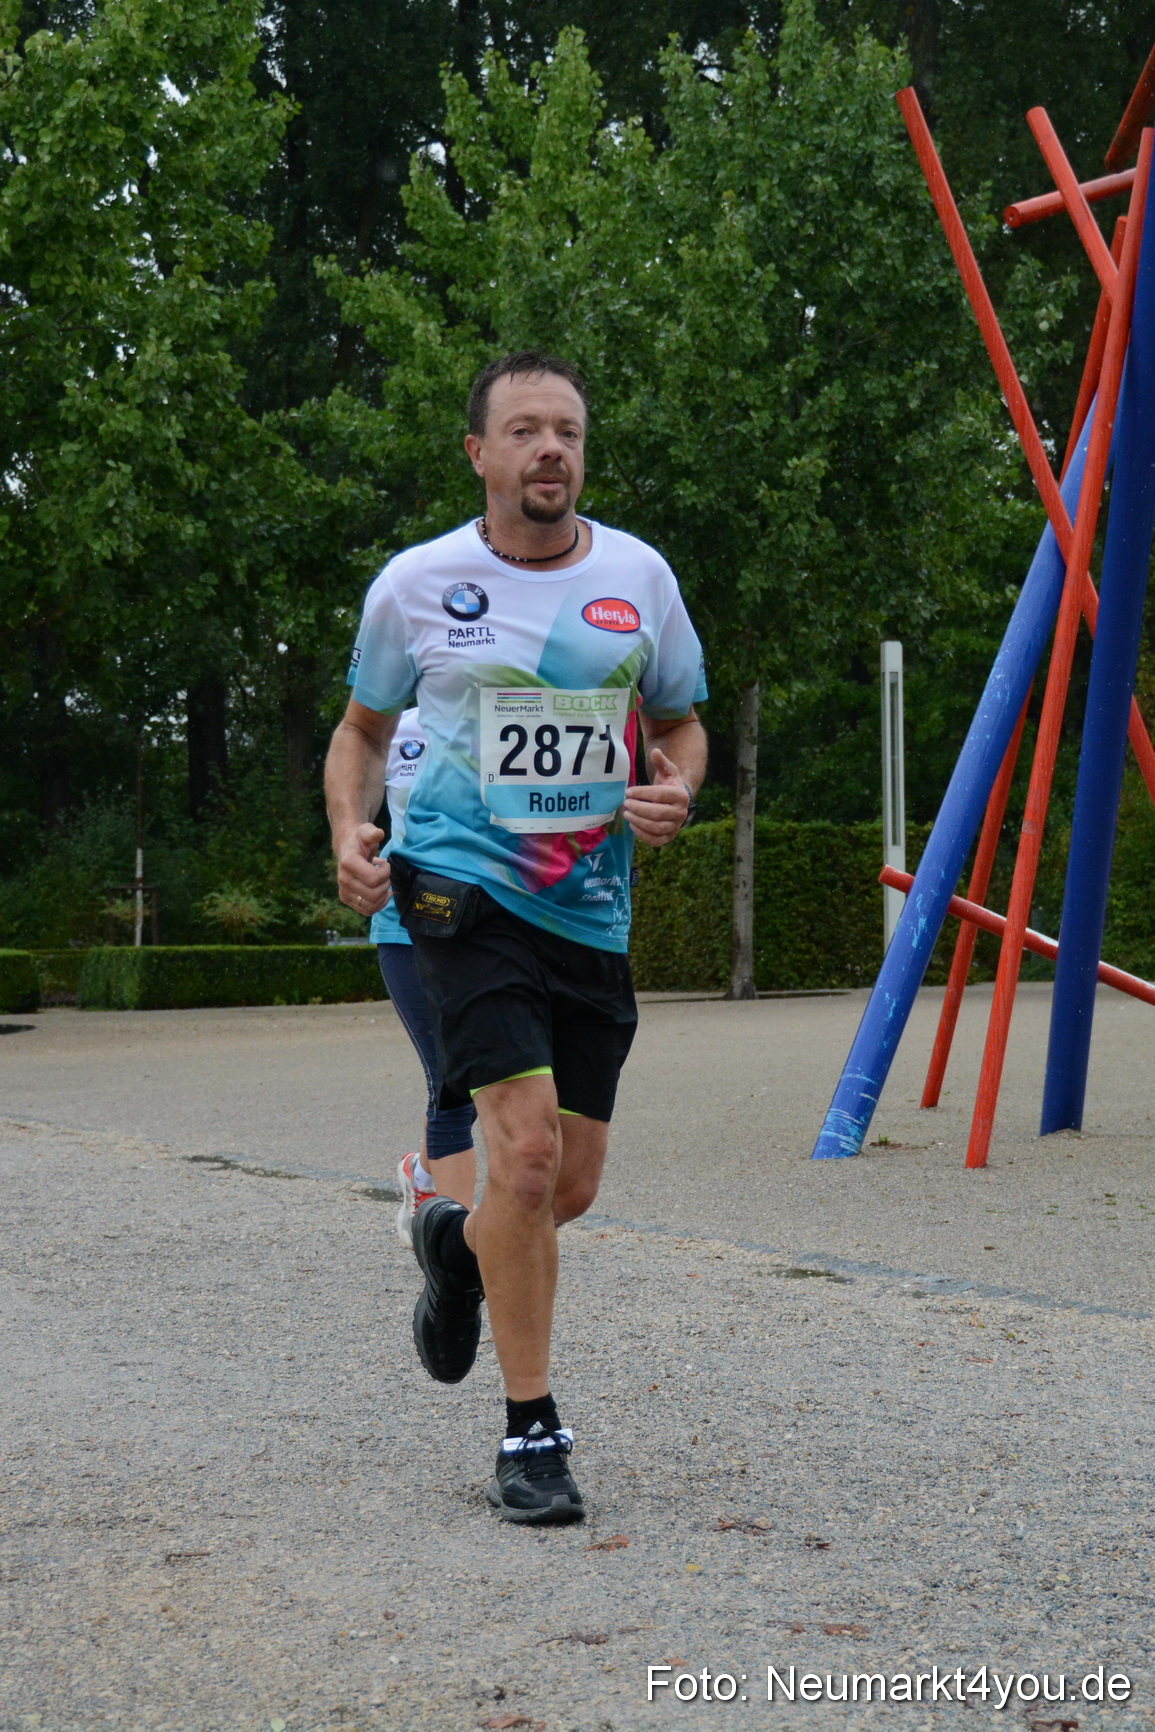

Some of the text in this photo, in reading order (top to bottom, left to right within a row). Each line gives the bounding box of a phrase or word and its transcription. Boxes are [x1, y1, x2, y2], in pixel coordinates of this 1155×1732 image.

[445, 583, 484, 597] BMW
[591, 607, 636, 624] Hervis
[448, 627, 495, 640] PARTL
[448, 637, 496, 648] Neumarkt
[494, 704, 544, 712] NeuerMarkt
[553, 694, 618, 711] BOCK
[499, 724, 616, 777] 2871
[488, 774, 495, 783] D
[529, 791, 590, 812] Robert
